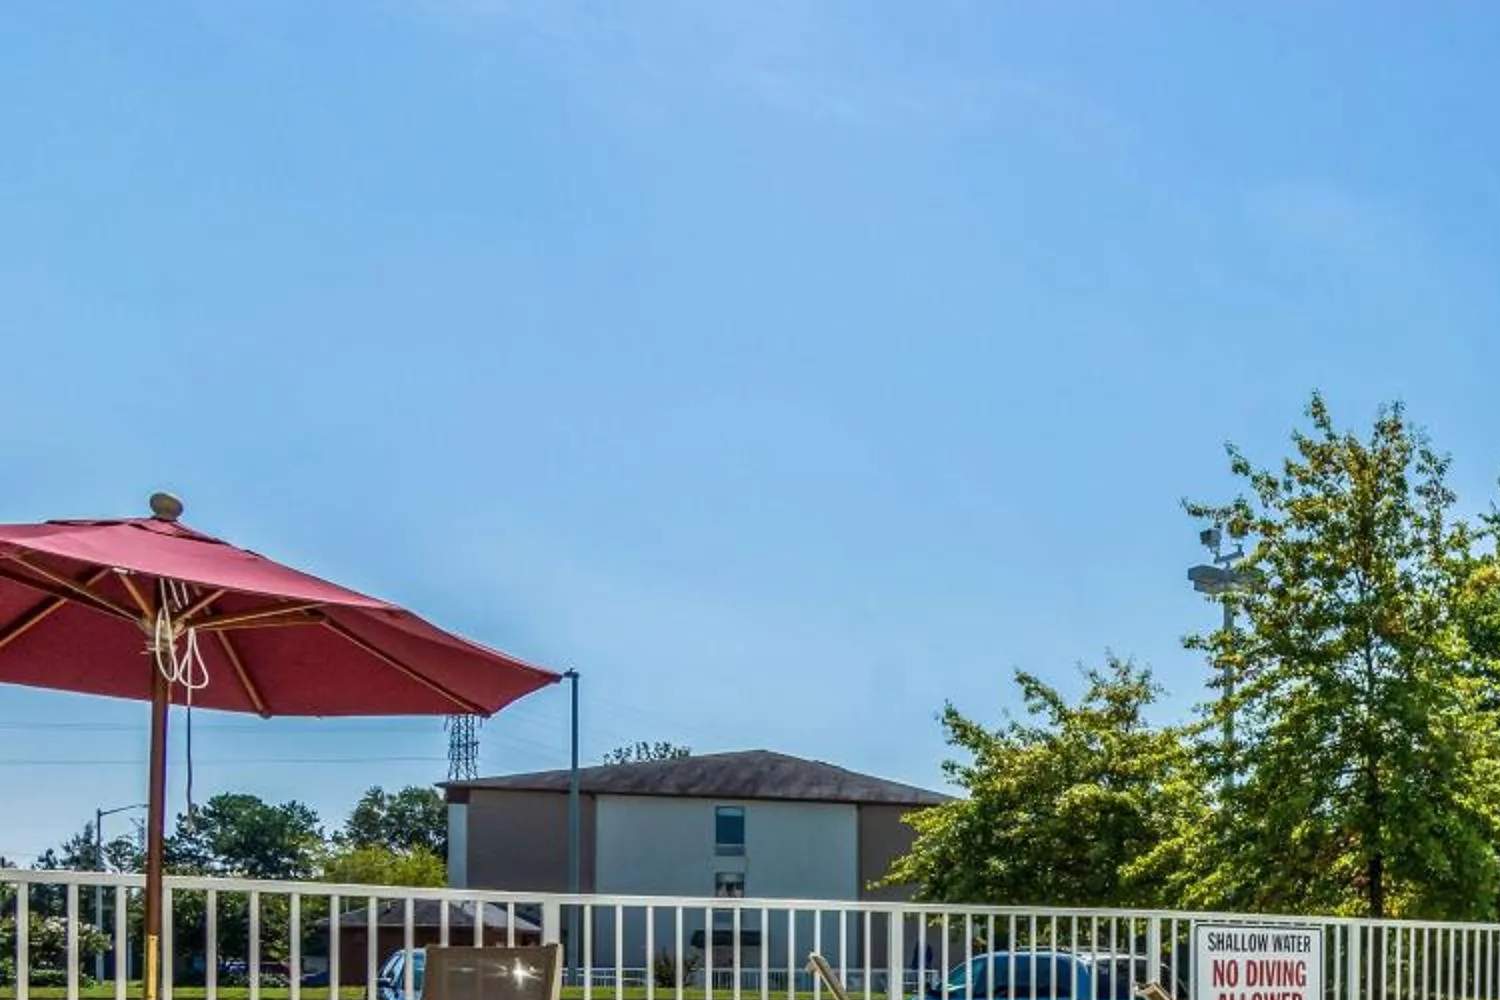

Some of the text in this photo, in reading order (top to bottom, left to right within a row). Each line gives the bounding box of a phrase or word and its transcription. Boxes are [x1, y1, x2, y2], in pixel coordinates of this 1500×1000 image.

[1207, 932, 1311, 953] SHALLOW WATER
[1213, 959, 1307, 988] NO DIVING
